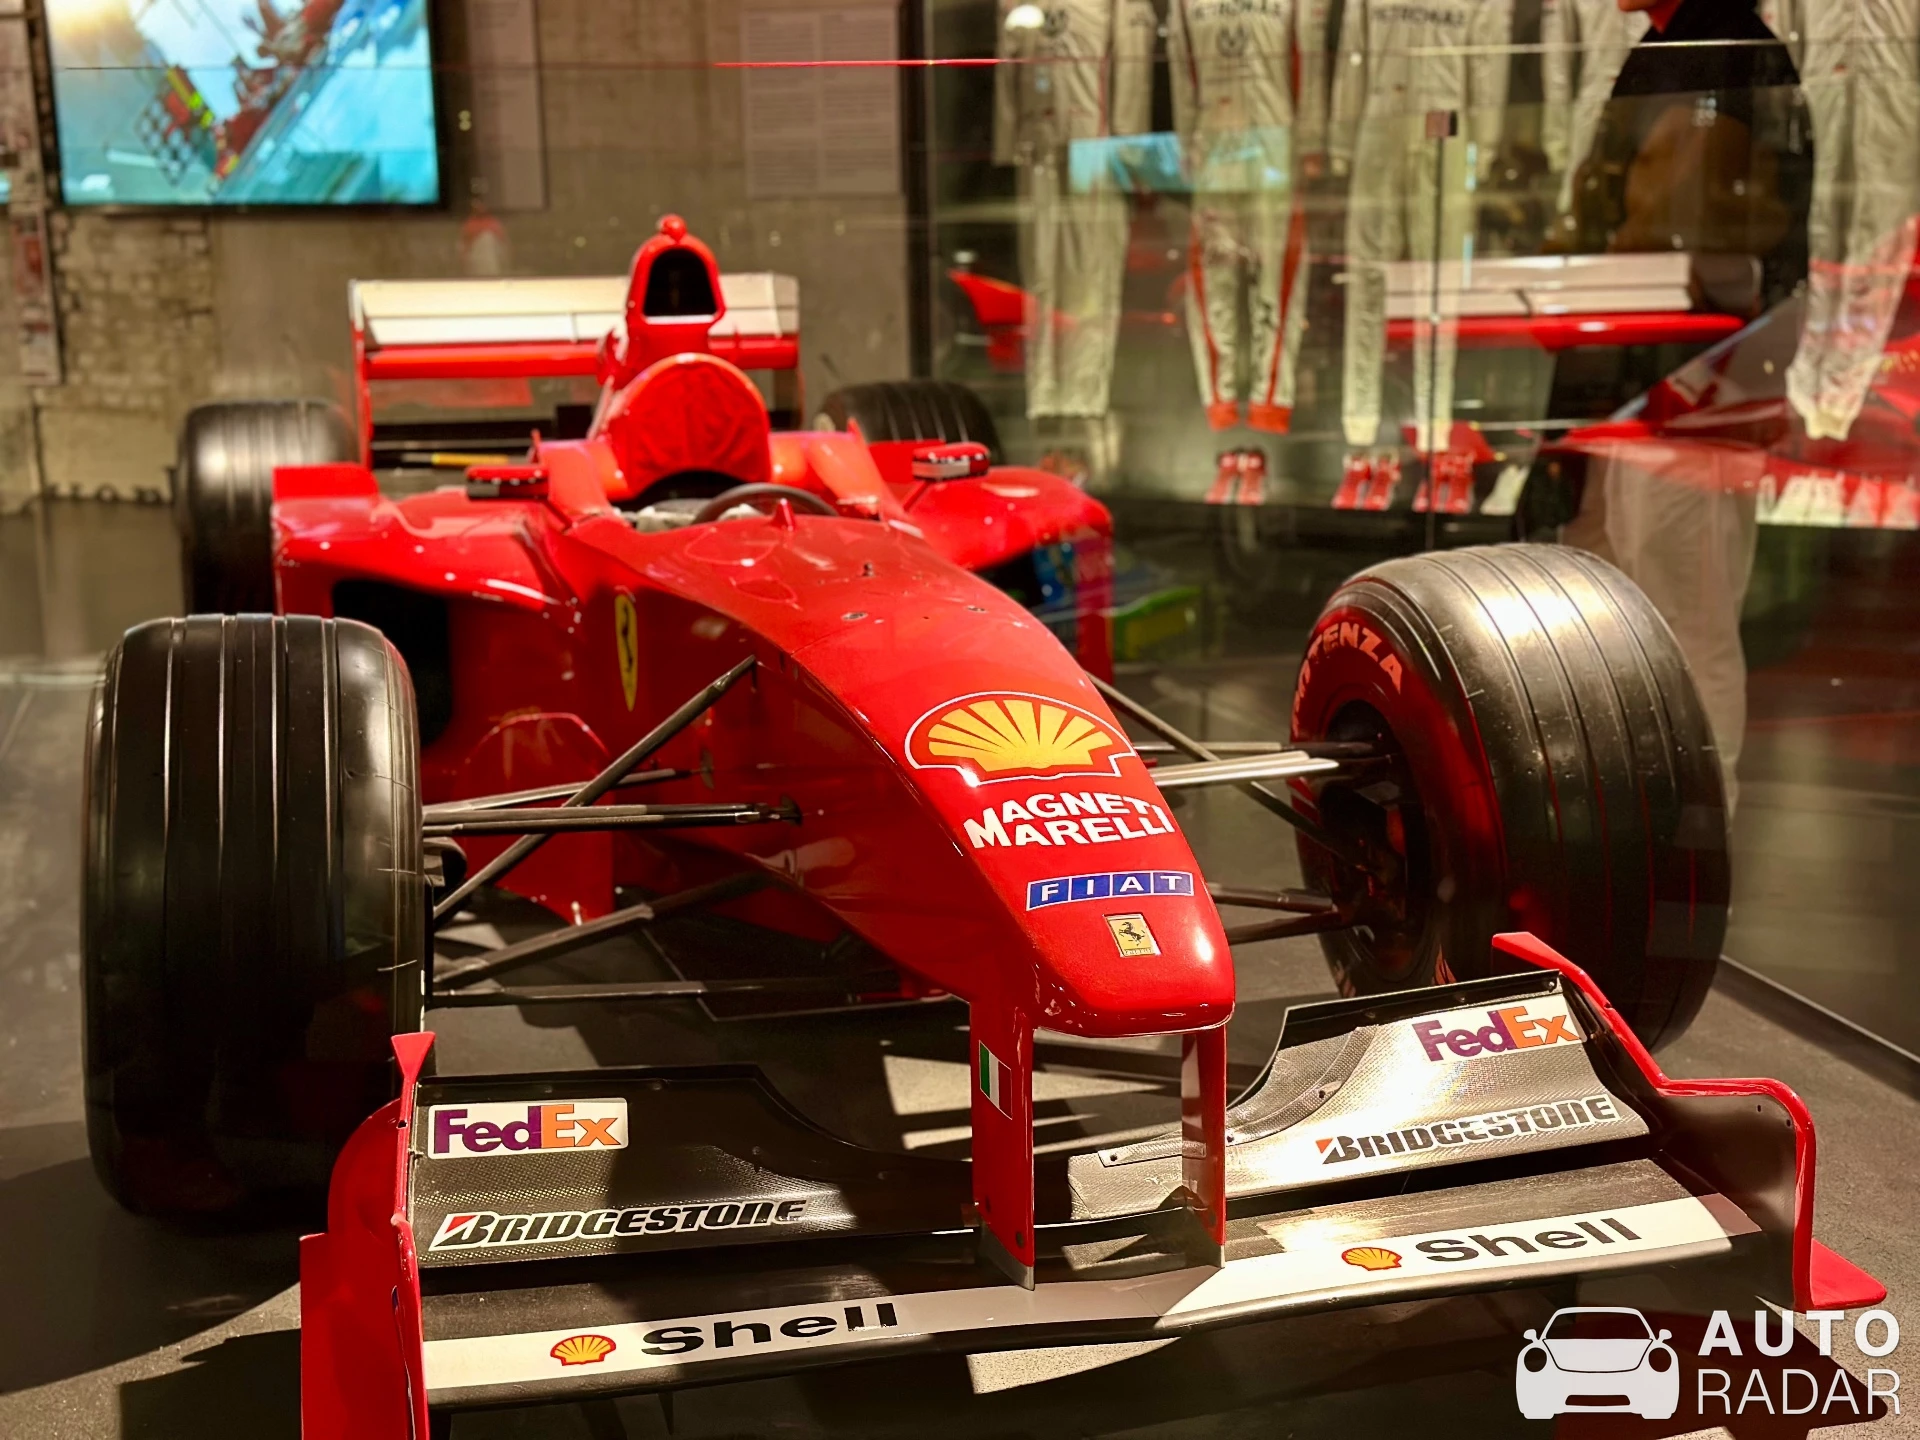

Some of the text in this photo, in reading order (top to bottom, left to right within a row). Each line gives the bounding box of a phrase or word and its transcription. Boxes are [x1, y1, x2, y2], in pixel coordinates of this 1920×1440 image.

[963, 806, 1176, 849] MARELLI
[1040, 874, 1184, 902] FIAT
[1411, 1005, 1582, 1063] FedEx
[433, 1103, 622, 1155] FedEx
[1316, 1095, 1619, 1165] BRIDGESTONE
[430, 1200, 807, 1251] BRIDGESTONE
[1415, 1217, 1643, 1263] Shell
[641, 1302, 899, 1356] Shell
